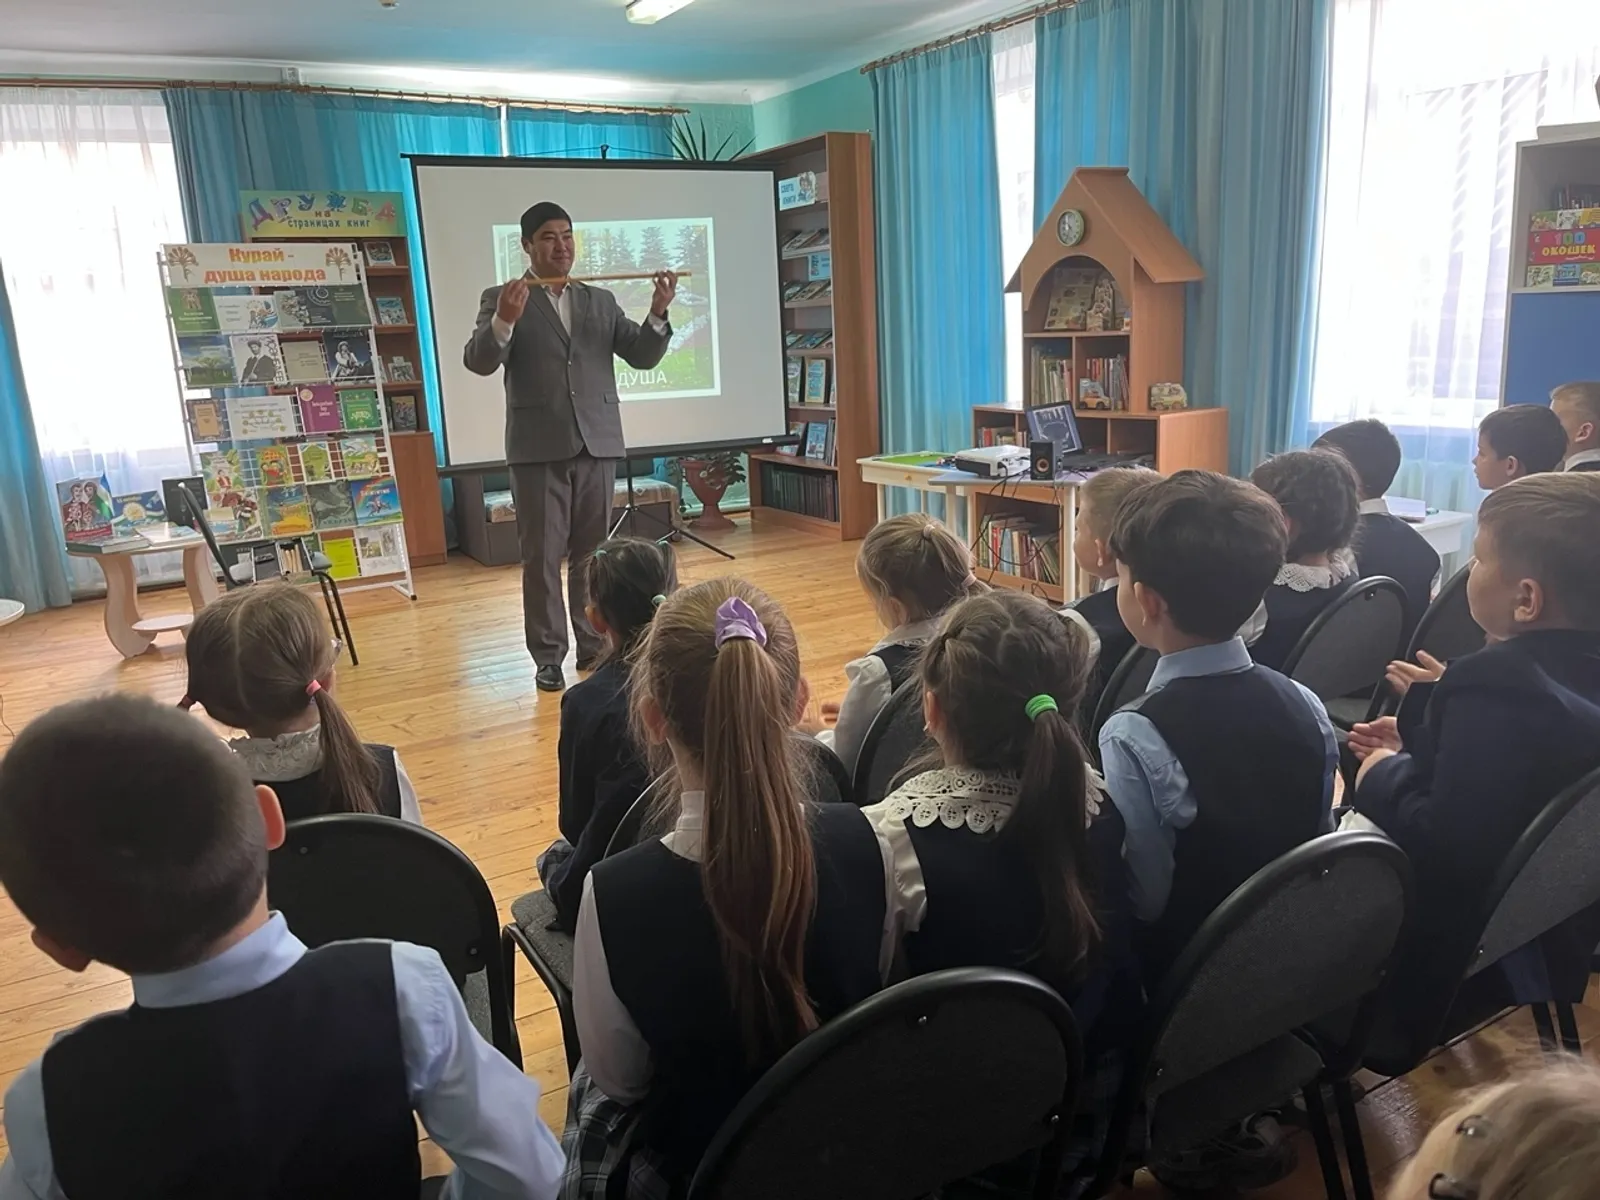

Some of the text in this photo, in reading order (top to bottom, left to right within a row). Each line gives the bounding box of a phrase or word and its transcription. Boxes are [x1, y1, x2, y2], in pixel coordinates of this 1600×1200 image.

[248, 191, 396, 231] ДРУЖБА
[287, 219, 370, 229] страницах книг
[1554, 231, 1586, 245] 100
[229, 247, 285, 263] Курай
[1542, 244, 1596, 256] ОКОШЕК
[204, 268, 326, 283] душа народа
[617, 370, 668, 389] ДУША
